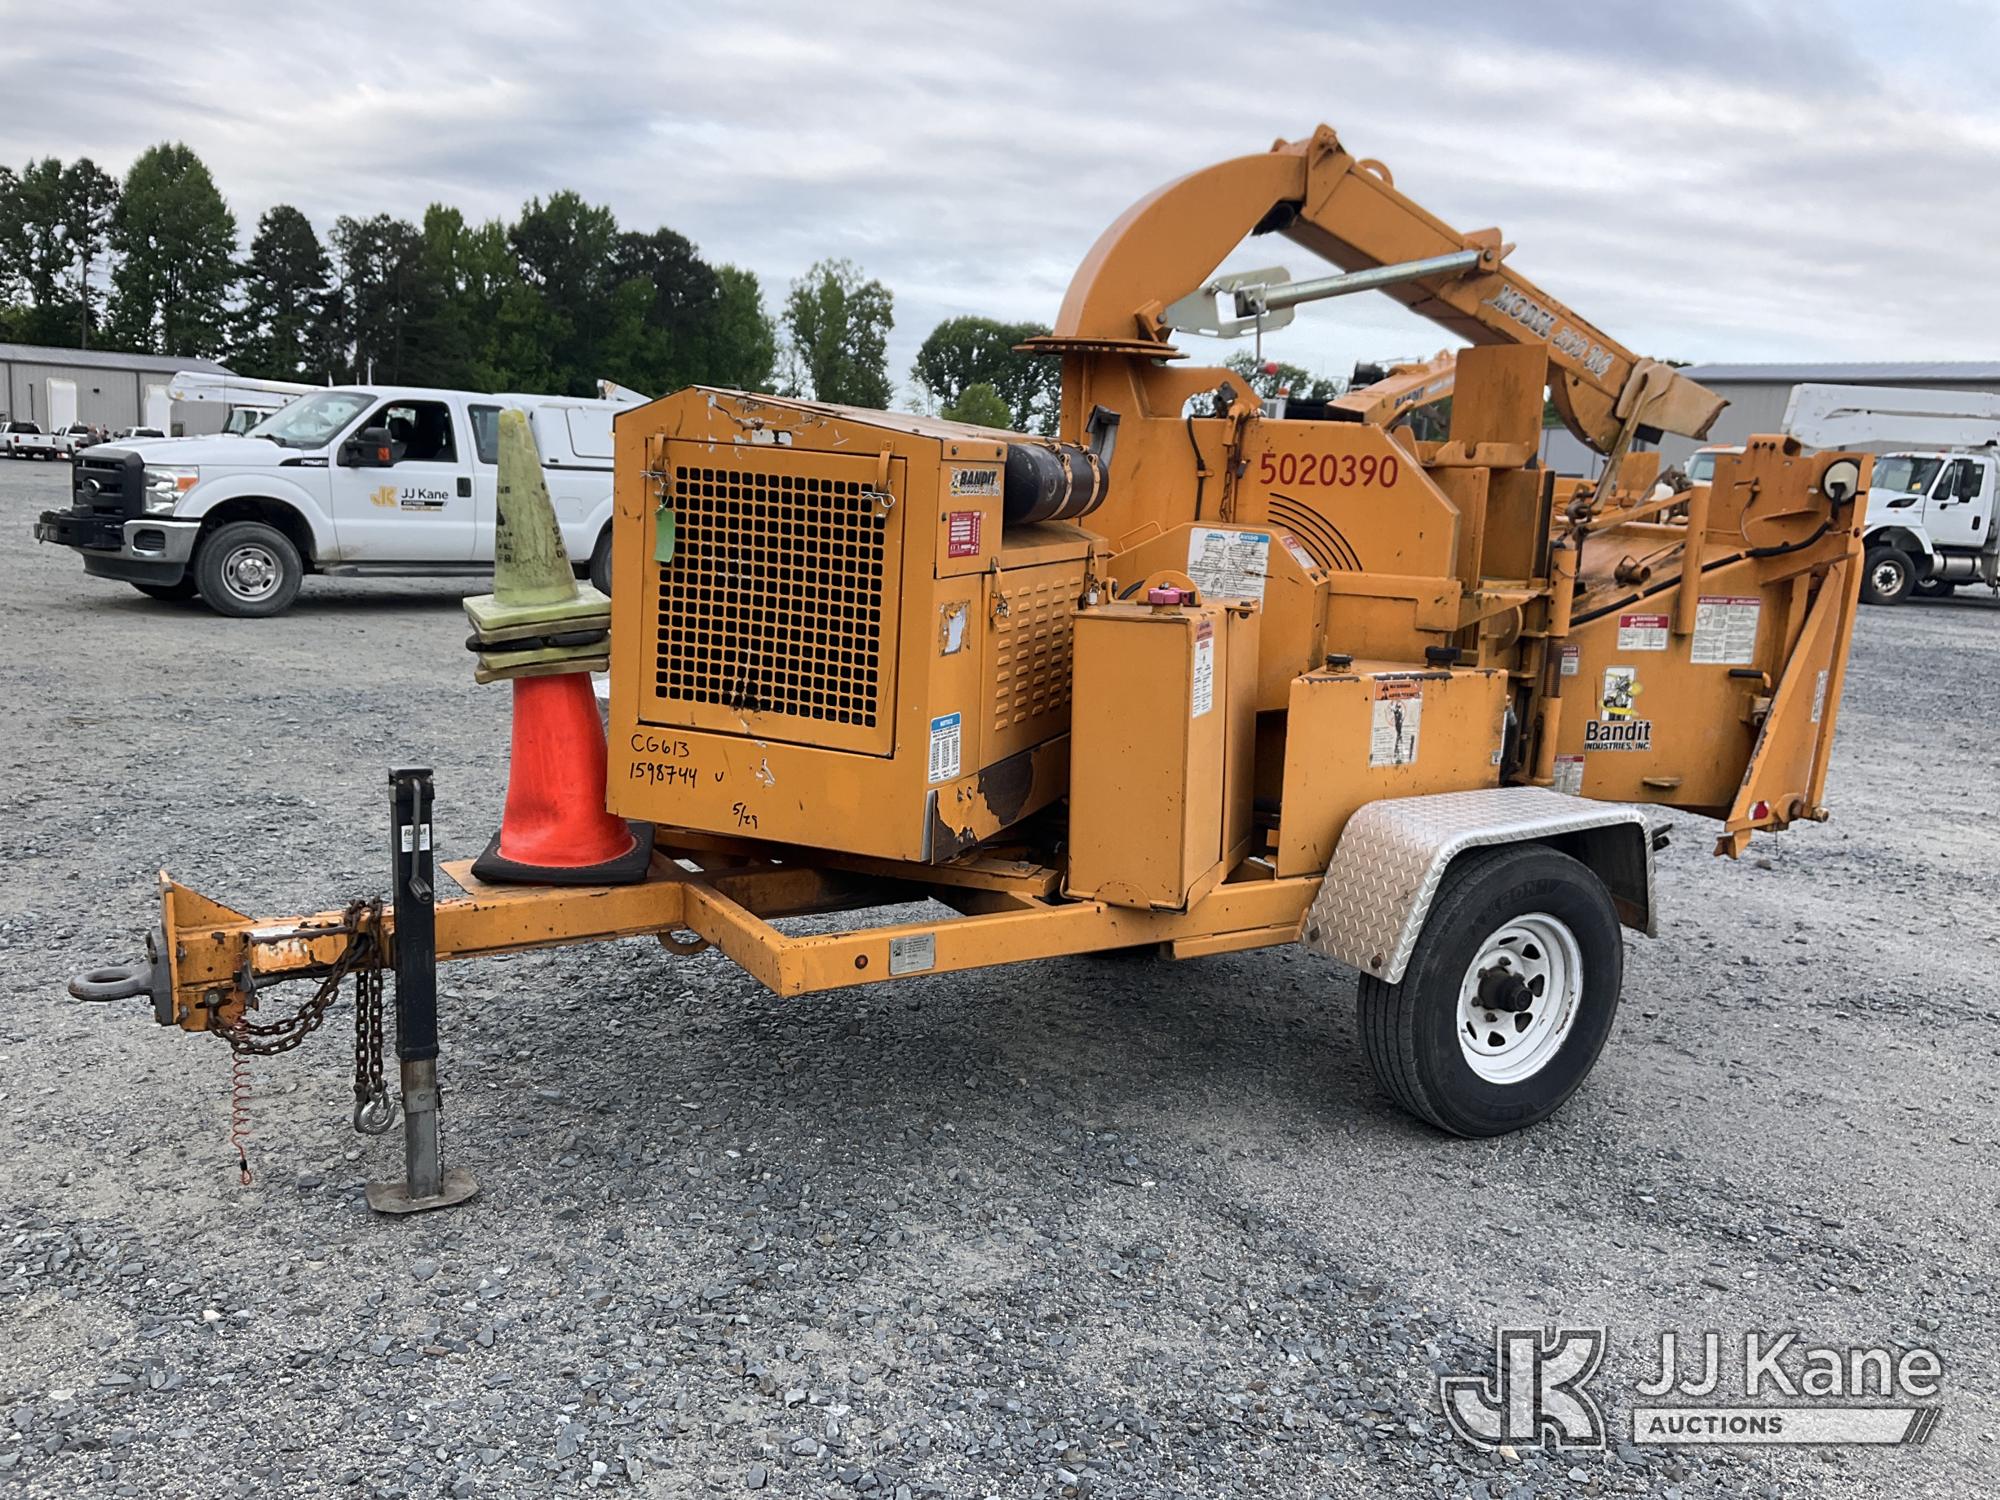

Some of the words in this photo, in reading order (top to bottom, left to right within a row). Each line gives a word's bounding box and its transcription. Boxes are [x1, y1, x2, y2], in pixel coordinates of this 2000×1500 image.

[1492, 284, 1556, 339] MODEL
[960, 470, 998, 487] BANDIT
[1259, 452, 1399, 489] 5020390
[401, 487, 415, 500] JJ
[418, 487, 449, 501] Kane
[1585, 720, 1651, 741] Bandit
[1635, 741, 1652, 751] INC.
[629, 762, 698, 789] 1598744
